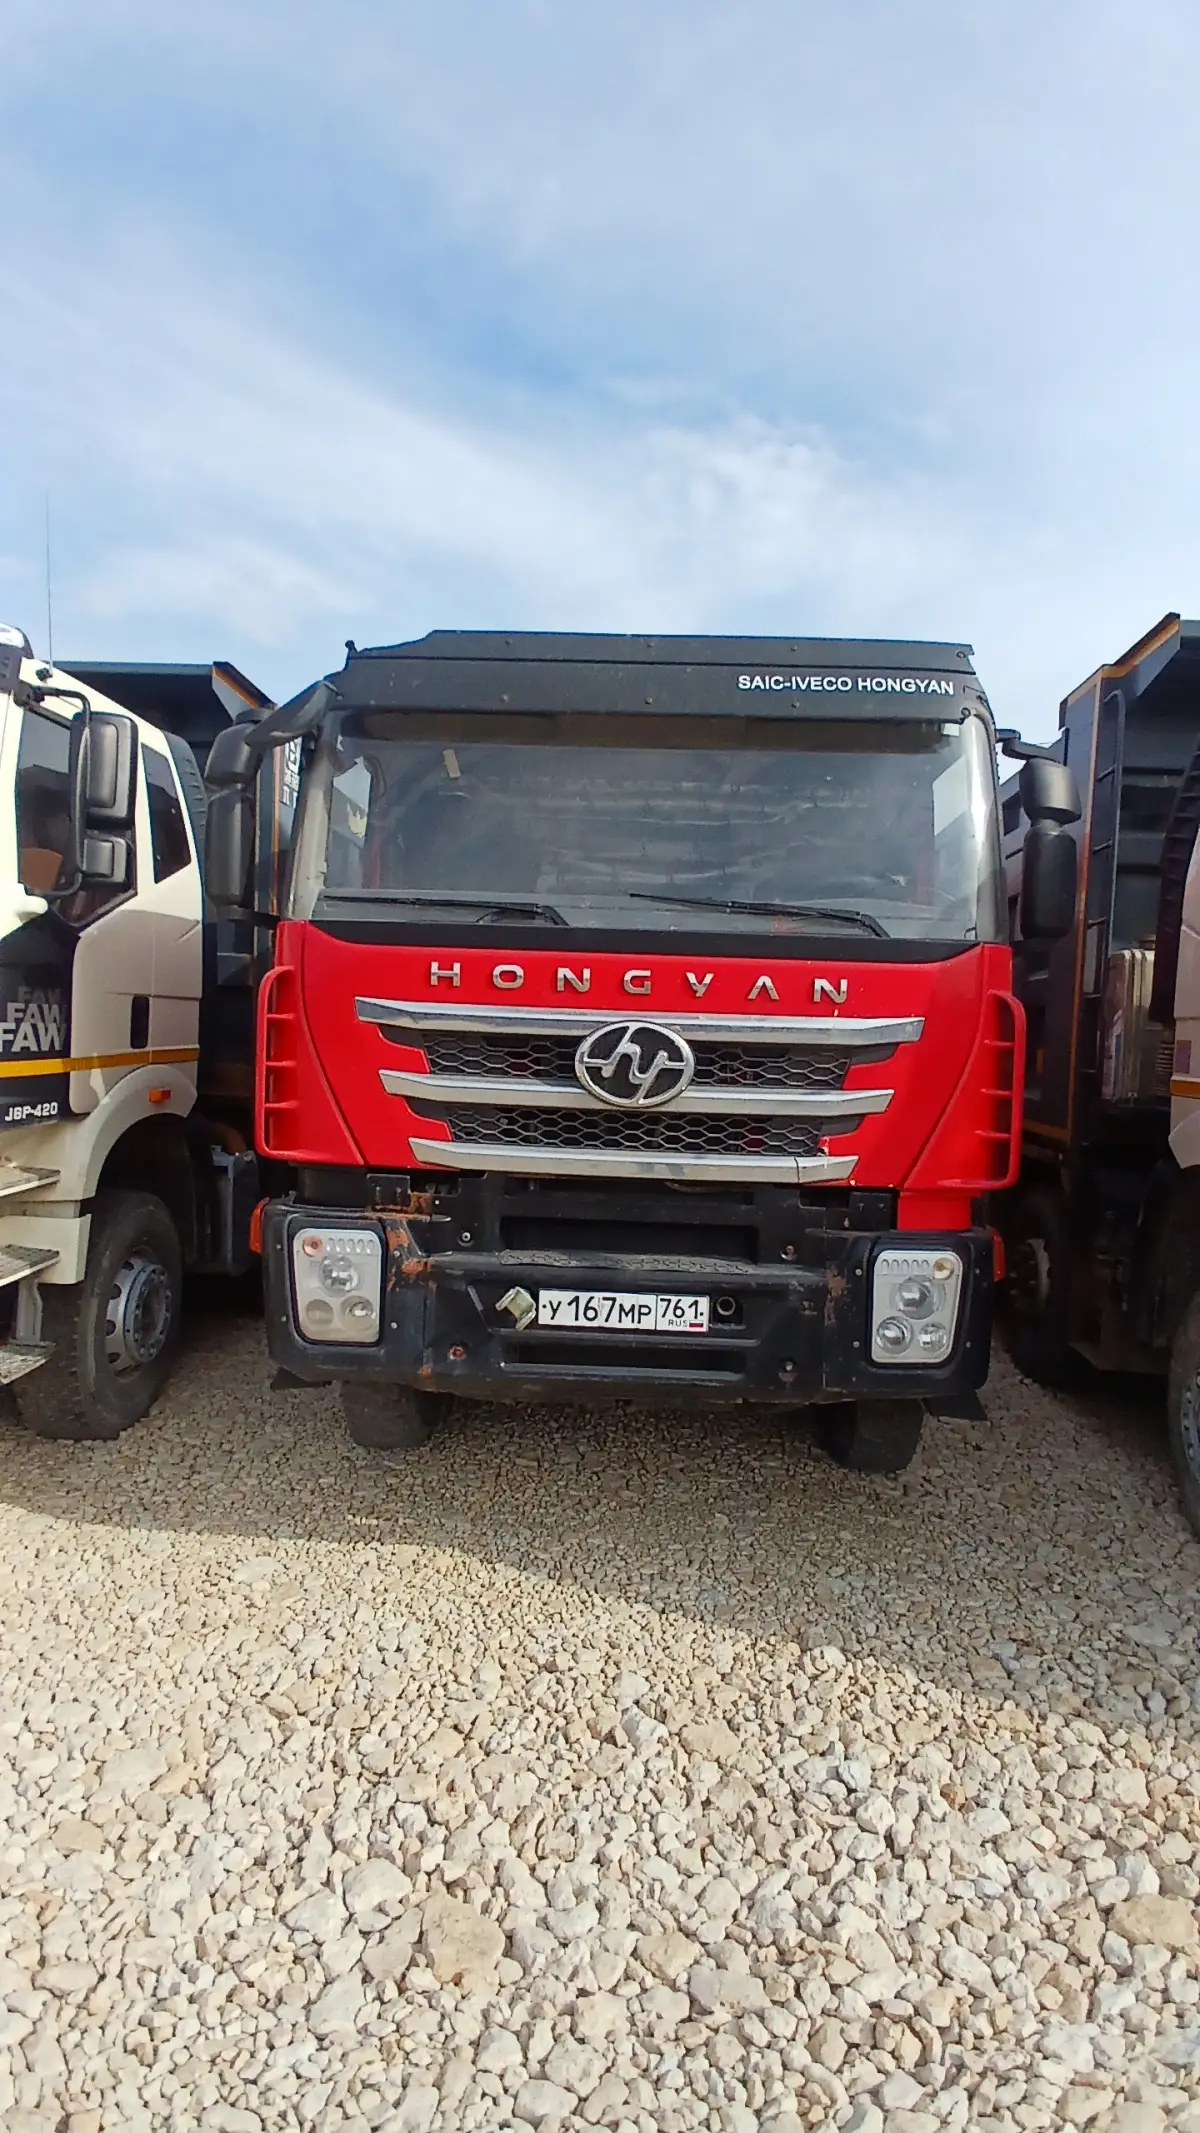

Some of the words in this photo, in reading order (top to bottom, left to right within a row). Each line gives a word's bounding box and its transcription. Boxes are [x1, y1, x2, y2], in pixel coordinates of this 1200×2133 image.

[738, 675, 852, 691] SAIC-IVECO
[858, 677, 954, 696] HONGYAN
[430, 961, 848, 1004] HONGYAN
[7, 1002, 60, 1025] FAW
[0, 1021, 66, 1052] FAW
[660, 1298, 699, 1319] 761
[668, 1319, 688, 1327] RUS
